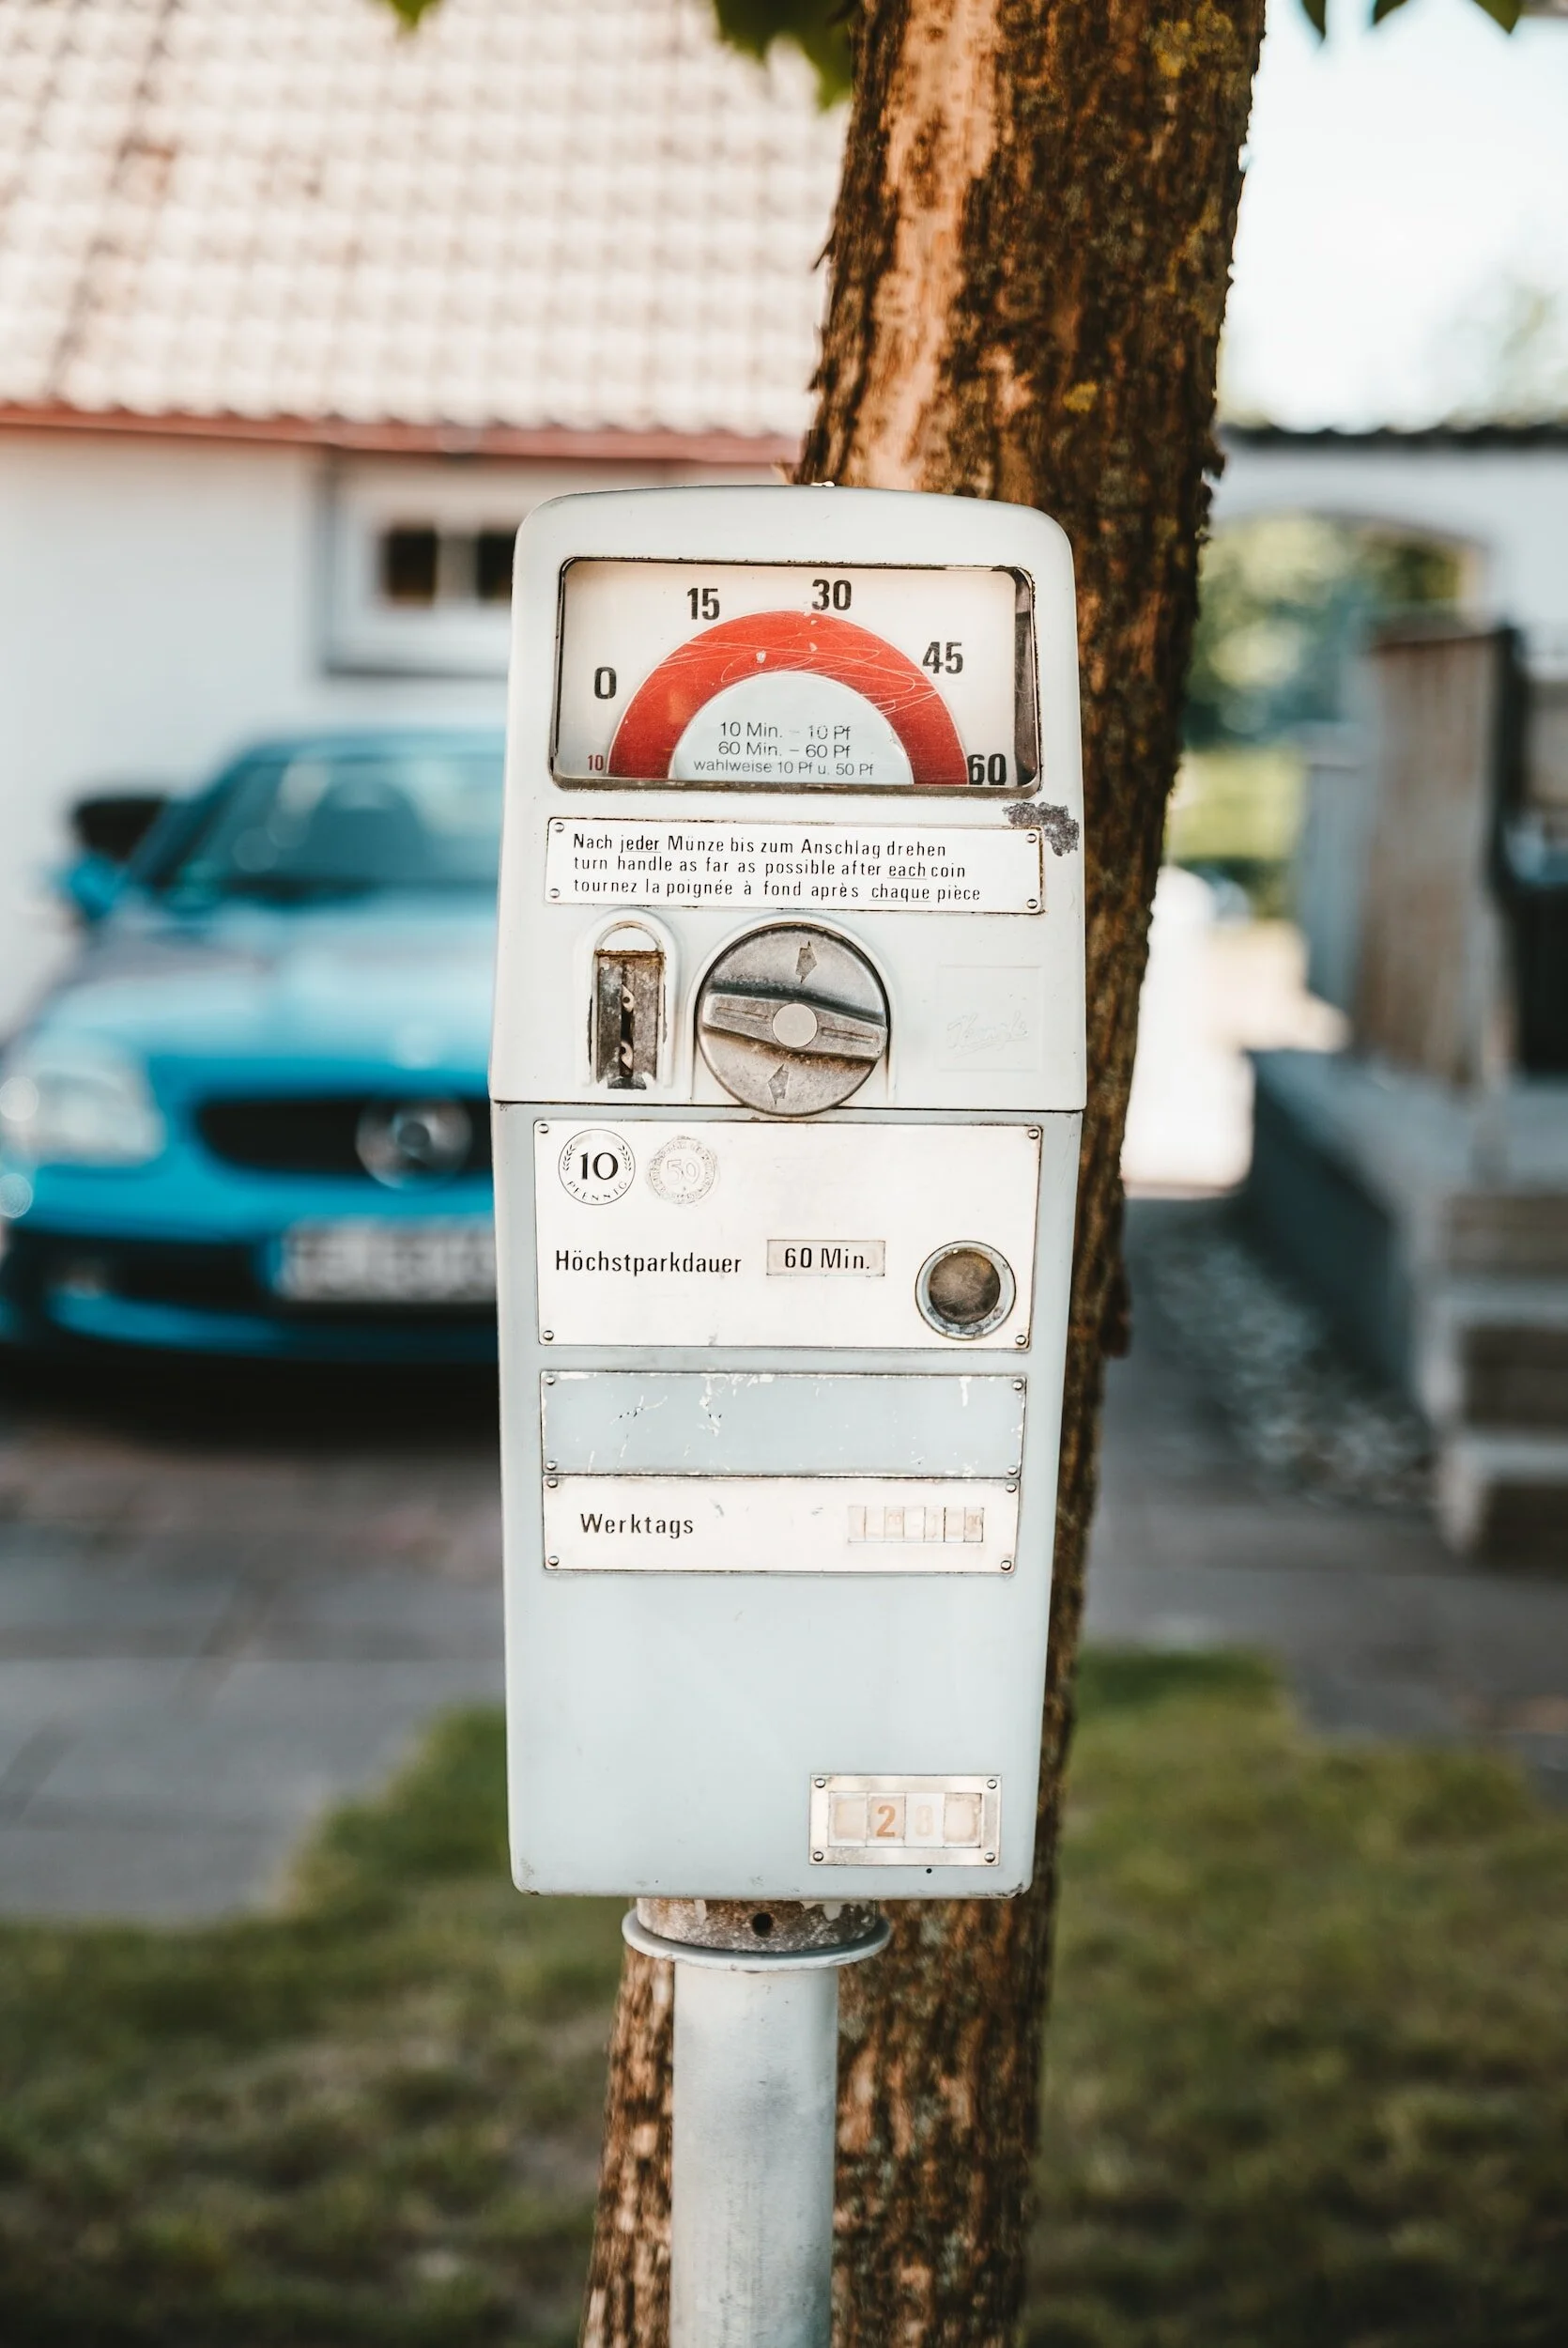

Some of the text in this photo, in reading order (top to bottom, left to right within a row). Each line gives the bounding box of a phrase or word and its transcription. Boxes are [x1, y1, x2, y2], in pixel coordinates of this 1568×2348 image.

[686, 587, 719, 620] 15
[811, 579, 852, 610] 30
[923, 641, 963, 674] 45
[593, 667, 617, 699] 0
[720, 722, 740, 736] 10
[746, 722, 782, 737] Min.
[808, 725, 828, 739] 10
[834, 726, 851, 740] Pf
[588, 755, 604, 770] 10
[718, 742, 740, 754] 60
[746, 742, 782, 756] Min.
[807, 745, 827, 758] 60
[834, 745, 851, 758] Pf
[694, 759, 874, 776] wahlweise 10 Pf u. 50 Pf
[967, 753, 1007, 785] 60
[573, 834, 945, 858] Nach jeder Münze bis zum Anschlag drehen
[574, 857, 965, 877] turn handle as far as possible after each coin
[574, 879, 980, 904] tournez la poignée à fond après chaque pièce
[580, 1151, 619, 1181] 10
[667, 1158, 699, 1187] 50
[556, 1250, 742, 1275] Höchstparkdauer
[784, 1247, 869, 1269] 60 Min.
[580, 1513, 693, 1539] Werktags
